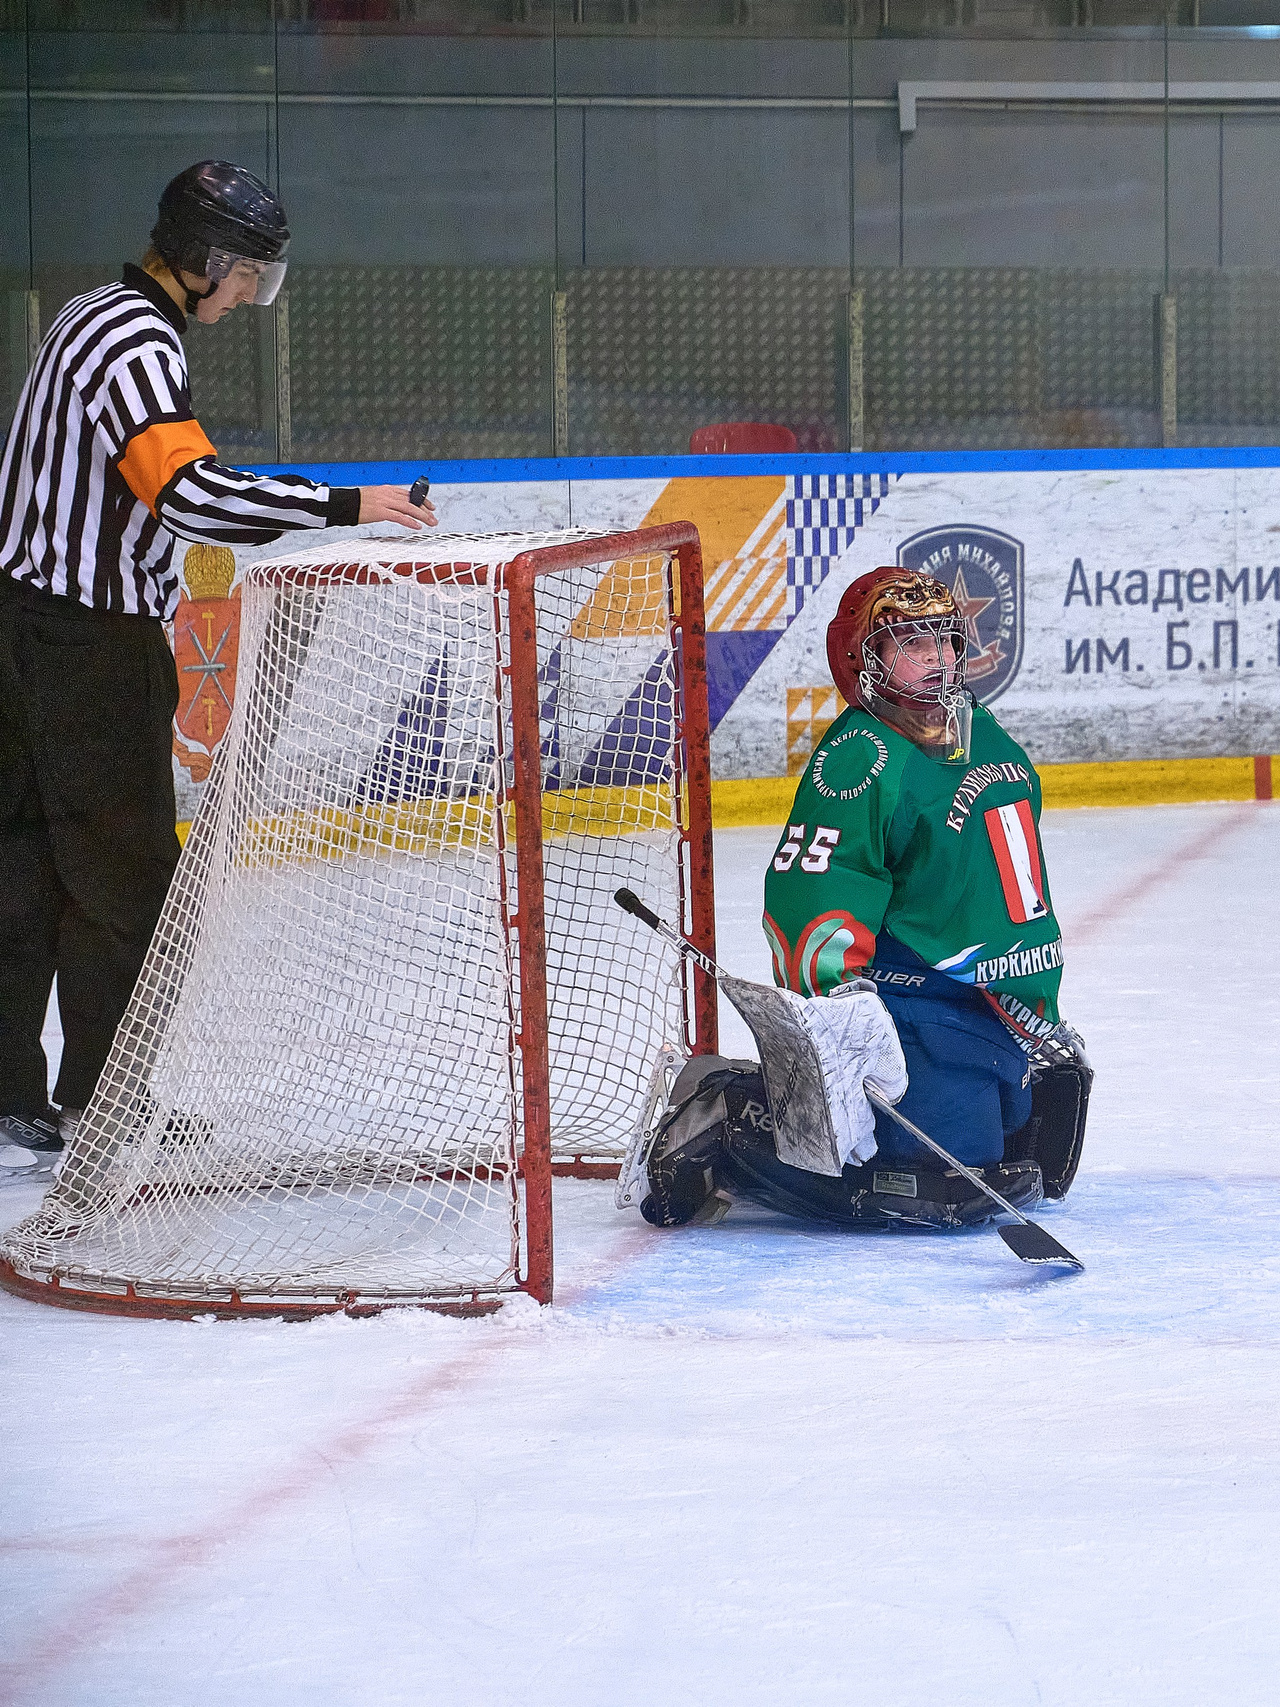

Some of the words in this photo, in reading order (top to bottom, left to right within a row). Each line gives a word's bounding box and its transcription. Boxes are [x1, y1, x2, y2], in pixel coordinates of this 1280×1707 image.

[1065, 637, 1145, 674] им.
[1165, 621, 1256, 671] Б.П.
[945, 763, 1003, 834] КУЛИКОВО
[1000, 762, 1033, 793] ПО
[774, 824, 841, 874] 55
[865, 969, 926, 987] AUER
